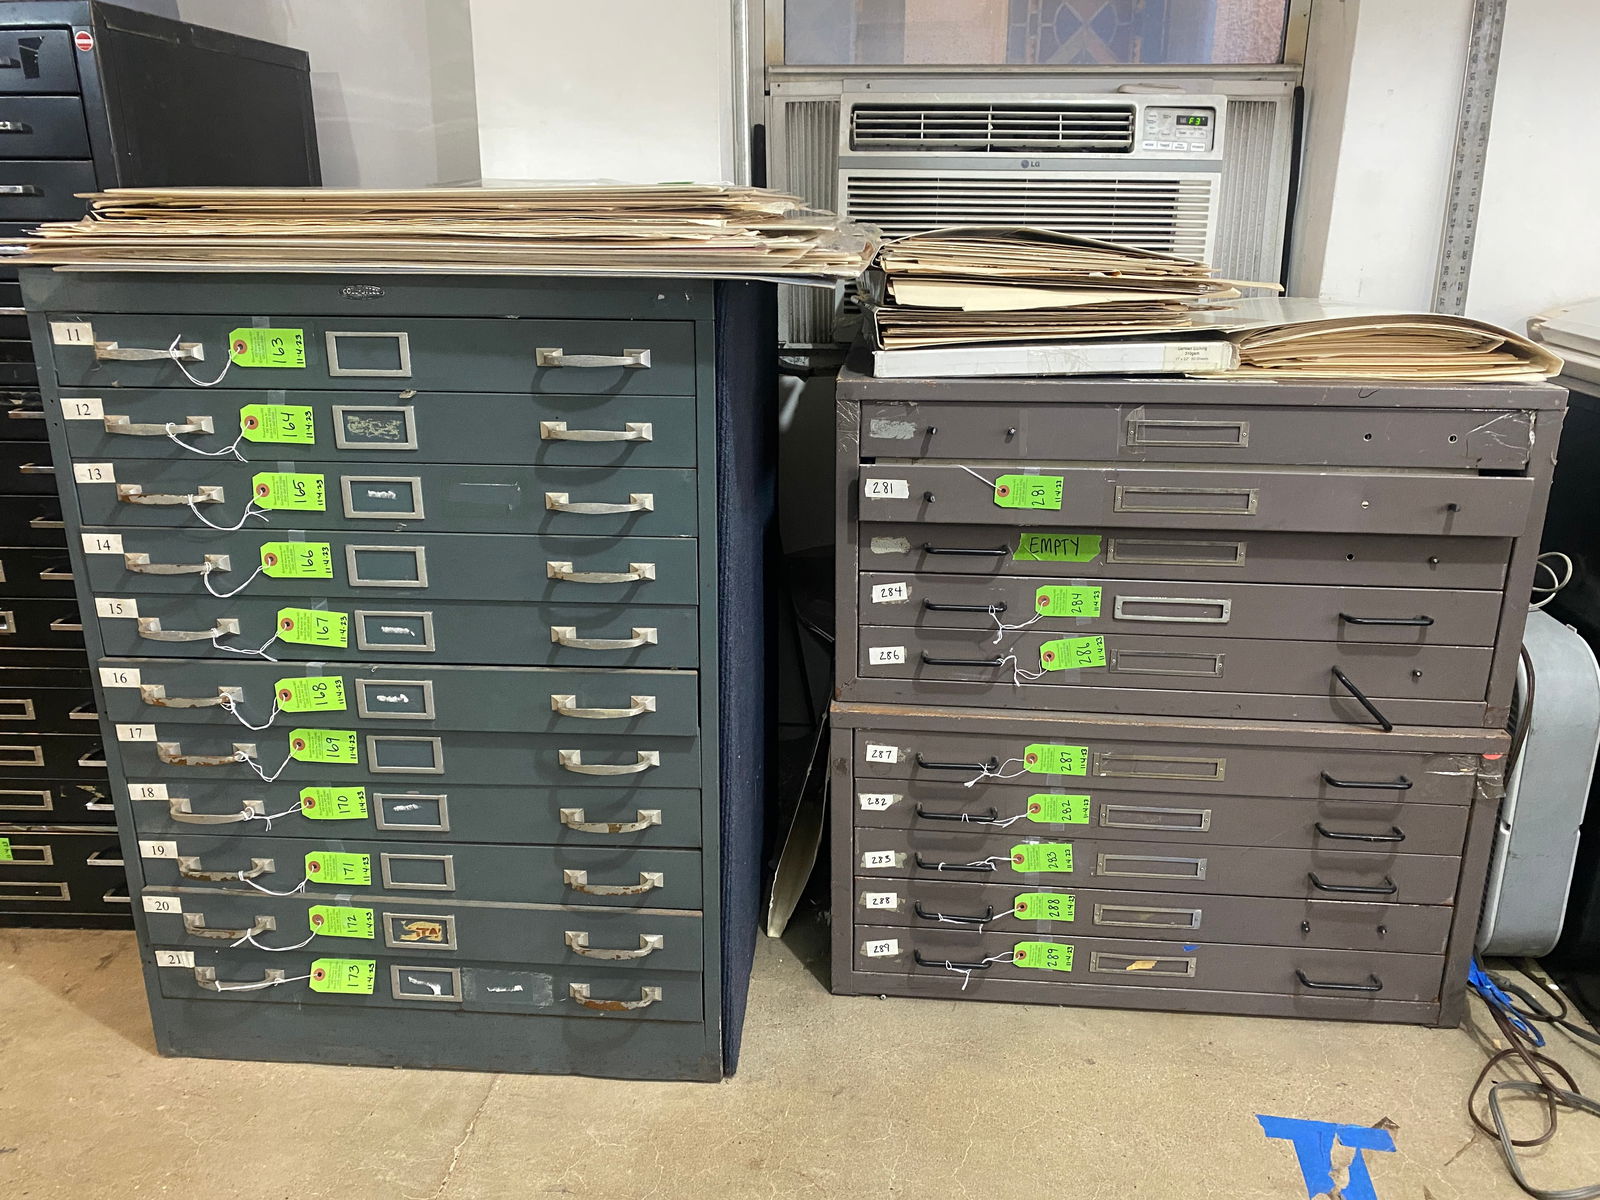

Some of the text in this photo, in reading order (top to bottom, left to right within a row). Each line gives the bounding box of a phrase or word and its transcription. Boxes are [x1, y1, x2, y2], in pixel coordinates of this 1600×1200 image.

[1030, 160, 1040, 168] LG
[68, 329, 80, 341] 11
[272, 338, 286, 364] 163
[77, 404, 91, 416] 12
[281, 413, 298, 437] 164
[88, 469, 102, 481] 13
[293, 480, 307, 503] 165
[873, 482, 893, 494] 281
[1032, 486, 1045, 506] 281
[97, 540, 111, 551] 14
[1030, 537, 1080, 556] EMPTY
[301, 550, 317, 572] 166
[881, 587, 902, 598] 284
[110, 604, 123, 615] 15
[1071, 594, 1084, 614] 284
[317, 618, 330, 641] 167
[880, 651, 900, 661] 286
[1077, 643, 1092, 664] 286
[114, 673, 128, 684] 16
[312, 683, 328, 706] 168
[130, 728, 142, 739] 17
[326, 738, 340, 758] 169
[872, 750, 892, 759] 287
[1060, 750, 1073, 772] 287
[142, 788, 155, 798] 18
[338, 796, 351, 814] 170
[868, 798, 887, 807] 282
[1062, 800, 1072, 821] 282
[152, 846, 165, 856] 19
[1047, 852, 1059, 869] 283
[343, 863, 355, 880] 171
[156, 901, 170, 911] 20
[873, 897, 890, 906] 288
[1048, 900, 1060, 918] 288
[348, 915, 358, 933] 172
[874, 944, 890, 953] 289
[168, 955, 181, 965] 21
[1047, 949, 1060, 967] 289
[349, 965, 360, 987] 173
